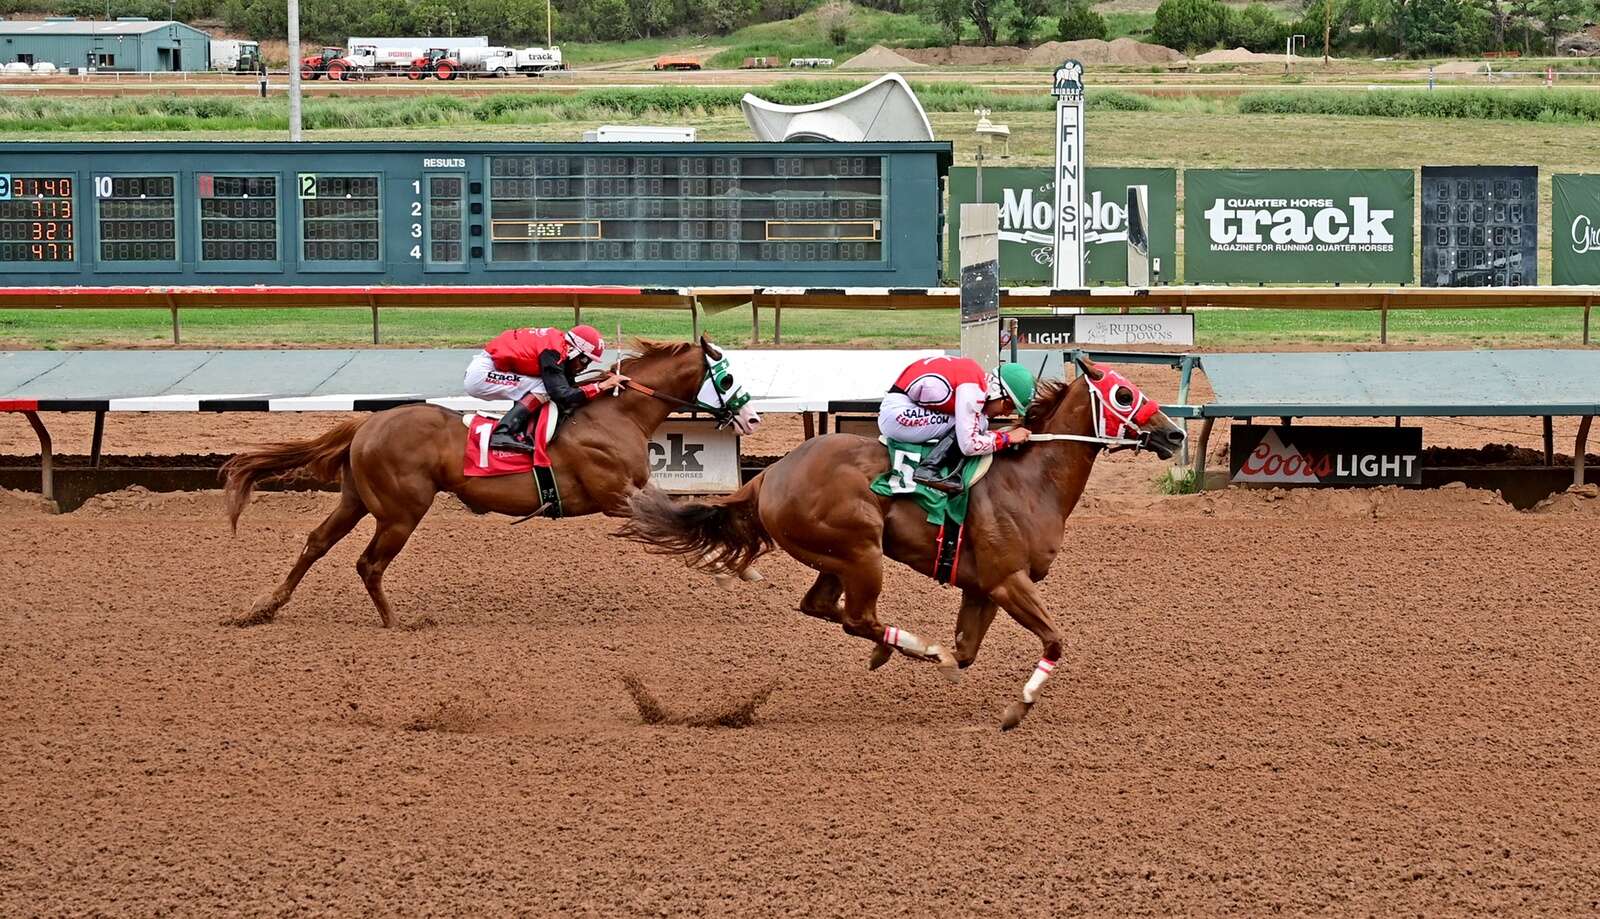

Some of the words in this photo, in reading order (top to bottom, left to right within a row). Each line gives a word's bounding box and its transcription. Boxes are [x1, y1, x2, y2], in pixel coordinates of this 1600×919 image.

[529, 53, 553, 61] track
[424, 158, 466, 168] RESULTS
[95, 176, 113, 198] 10
[298, 176, 316, 197] 12
[412, 181, 421, 194] 1
[1062, 125, 1077, 241] FINISH
[32, 201, 71, 218] 713
[411, 203, 422, 216] 2
[1228, 199, 1287, 208] QUARTER
[1290, 199, 1333, 208] HORSE
[1204, 196, 1394, 244] track
[32, 222, 71, 240] 321
[411, 225, 422, 237] 3
[528, 224, 563, 236] FAST
[32, 244, 72, 260] 471
[410, 246, 422, 259] 4
[1210, 244, 1254, 252] MAGAZINE
[1256, 244, 1273, 252] FOR
[1276, 244, 1313, 252] RUNNING
[1316, 244, 1356, 252] QUARTER
[1358, 244, 1394, 252] HORSES
[1109, 323, 1162, 335] RUIDOSO
[1028, 332, 1071, 344] LIGHT
[1125, 332, 1173, 344] DOWNS
[487, 371, 522, 382] track
[474, 423, 493, 468] 1
[1242, 442, 1334, 477] Coors
[1336, 454, 1416, 477] LIGHT
[888, 449, 921, 493] 5
